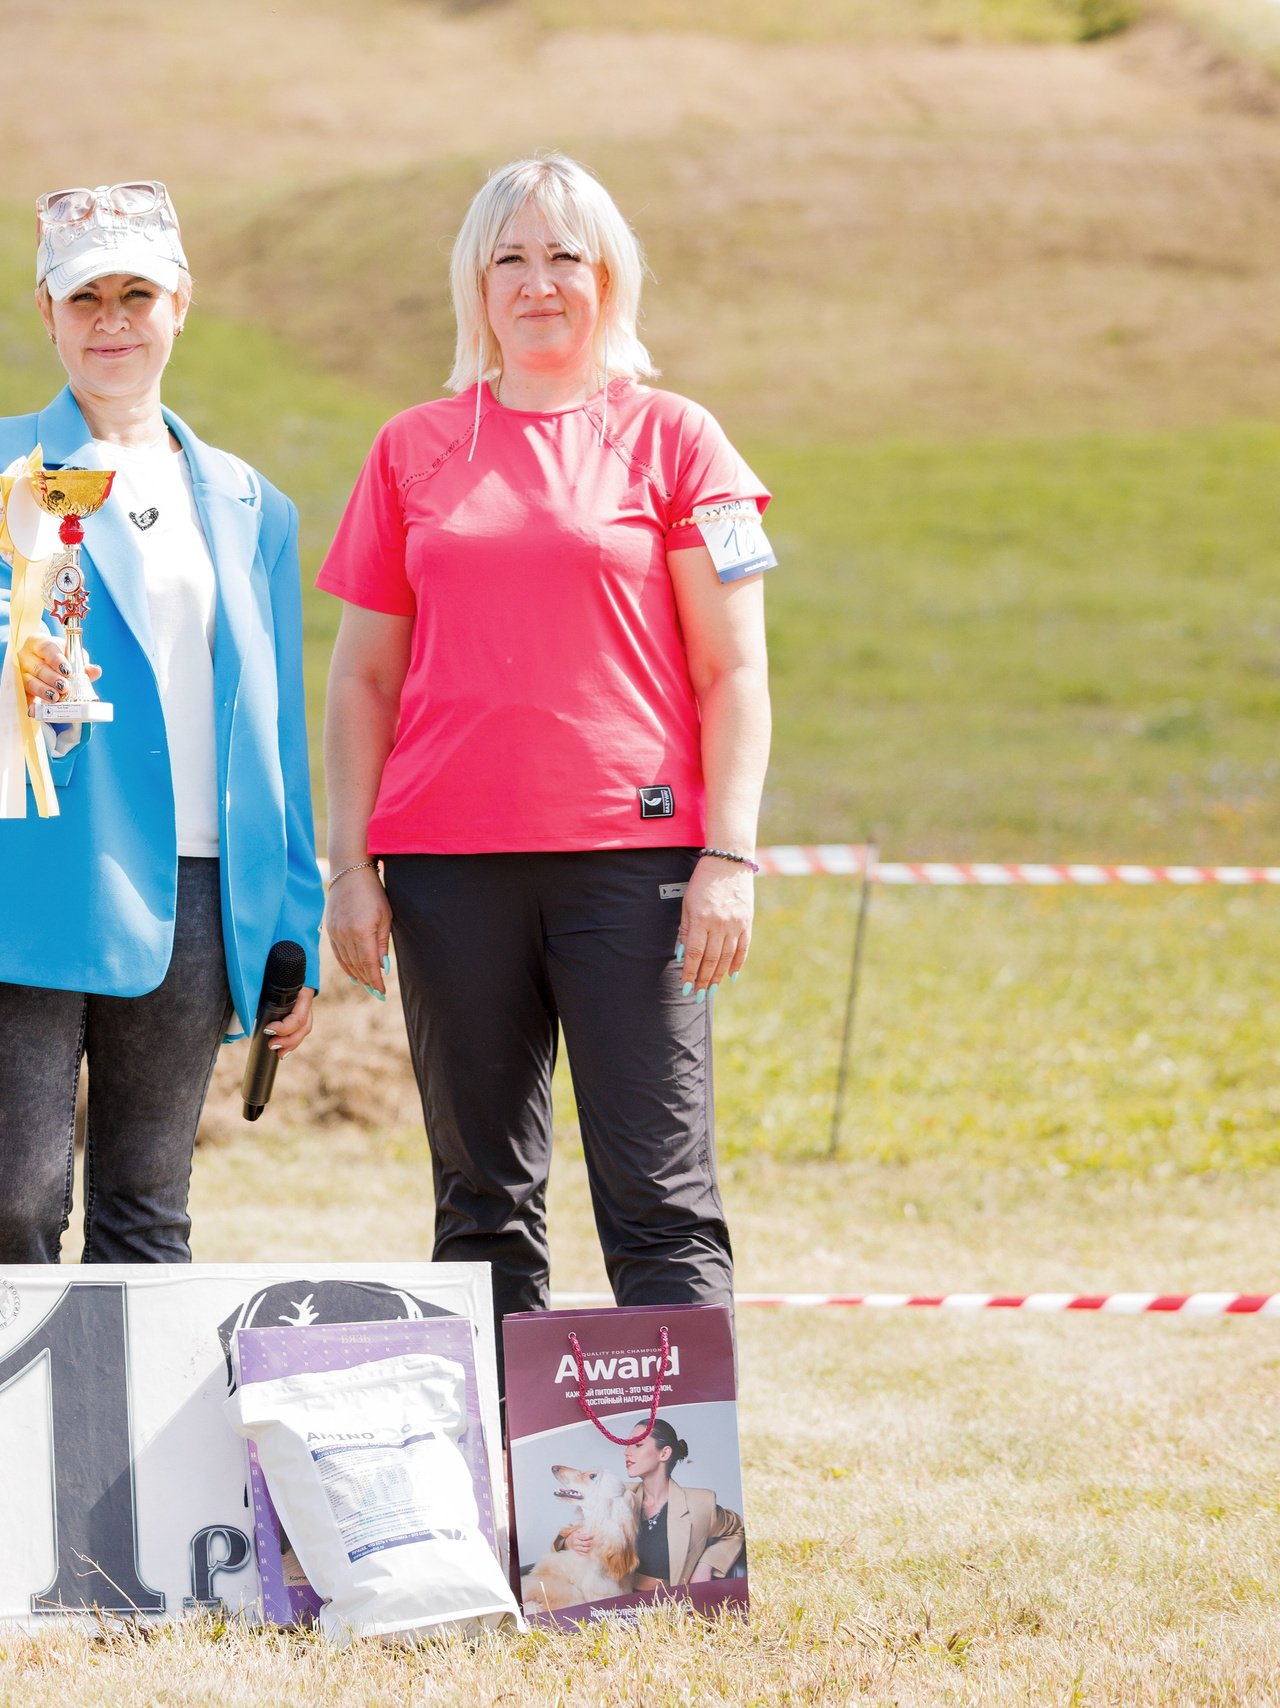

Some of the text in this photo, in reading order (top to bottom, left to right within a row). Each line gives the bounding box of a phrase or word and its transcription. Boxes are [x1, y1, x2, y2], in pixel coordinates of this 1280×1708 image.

[341, 1334, 371, 1345] БЯЗЬ
[554, 1346, 680, 1384] Award
[565, 1388, 594, 1398] КАЖЫЙ
[595, 1386, 624, 1397] ПИТОМЕЦ
[629, 1385, 641, 1393] ЭТО
[641, 1384, 673, 1393] ЧЕМИОН,
